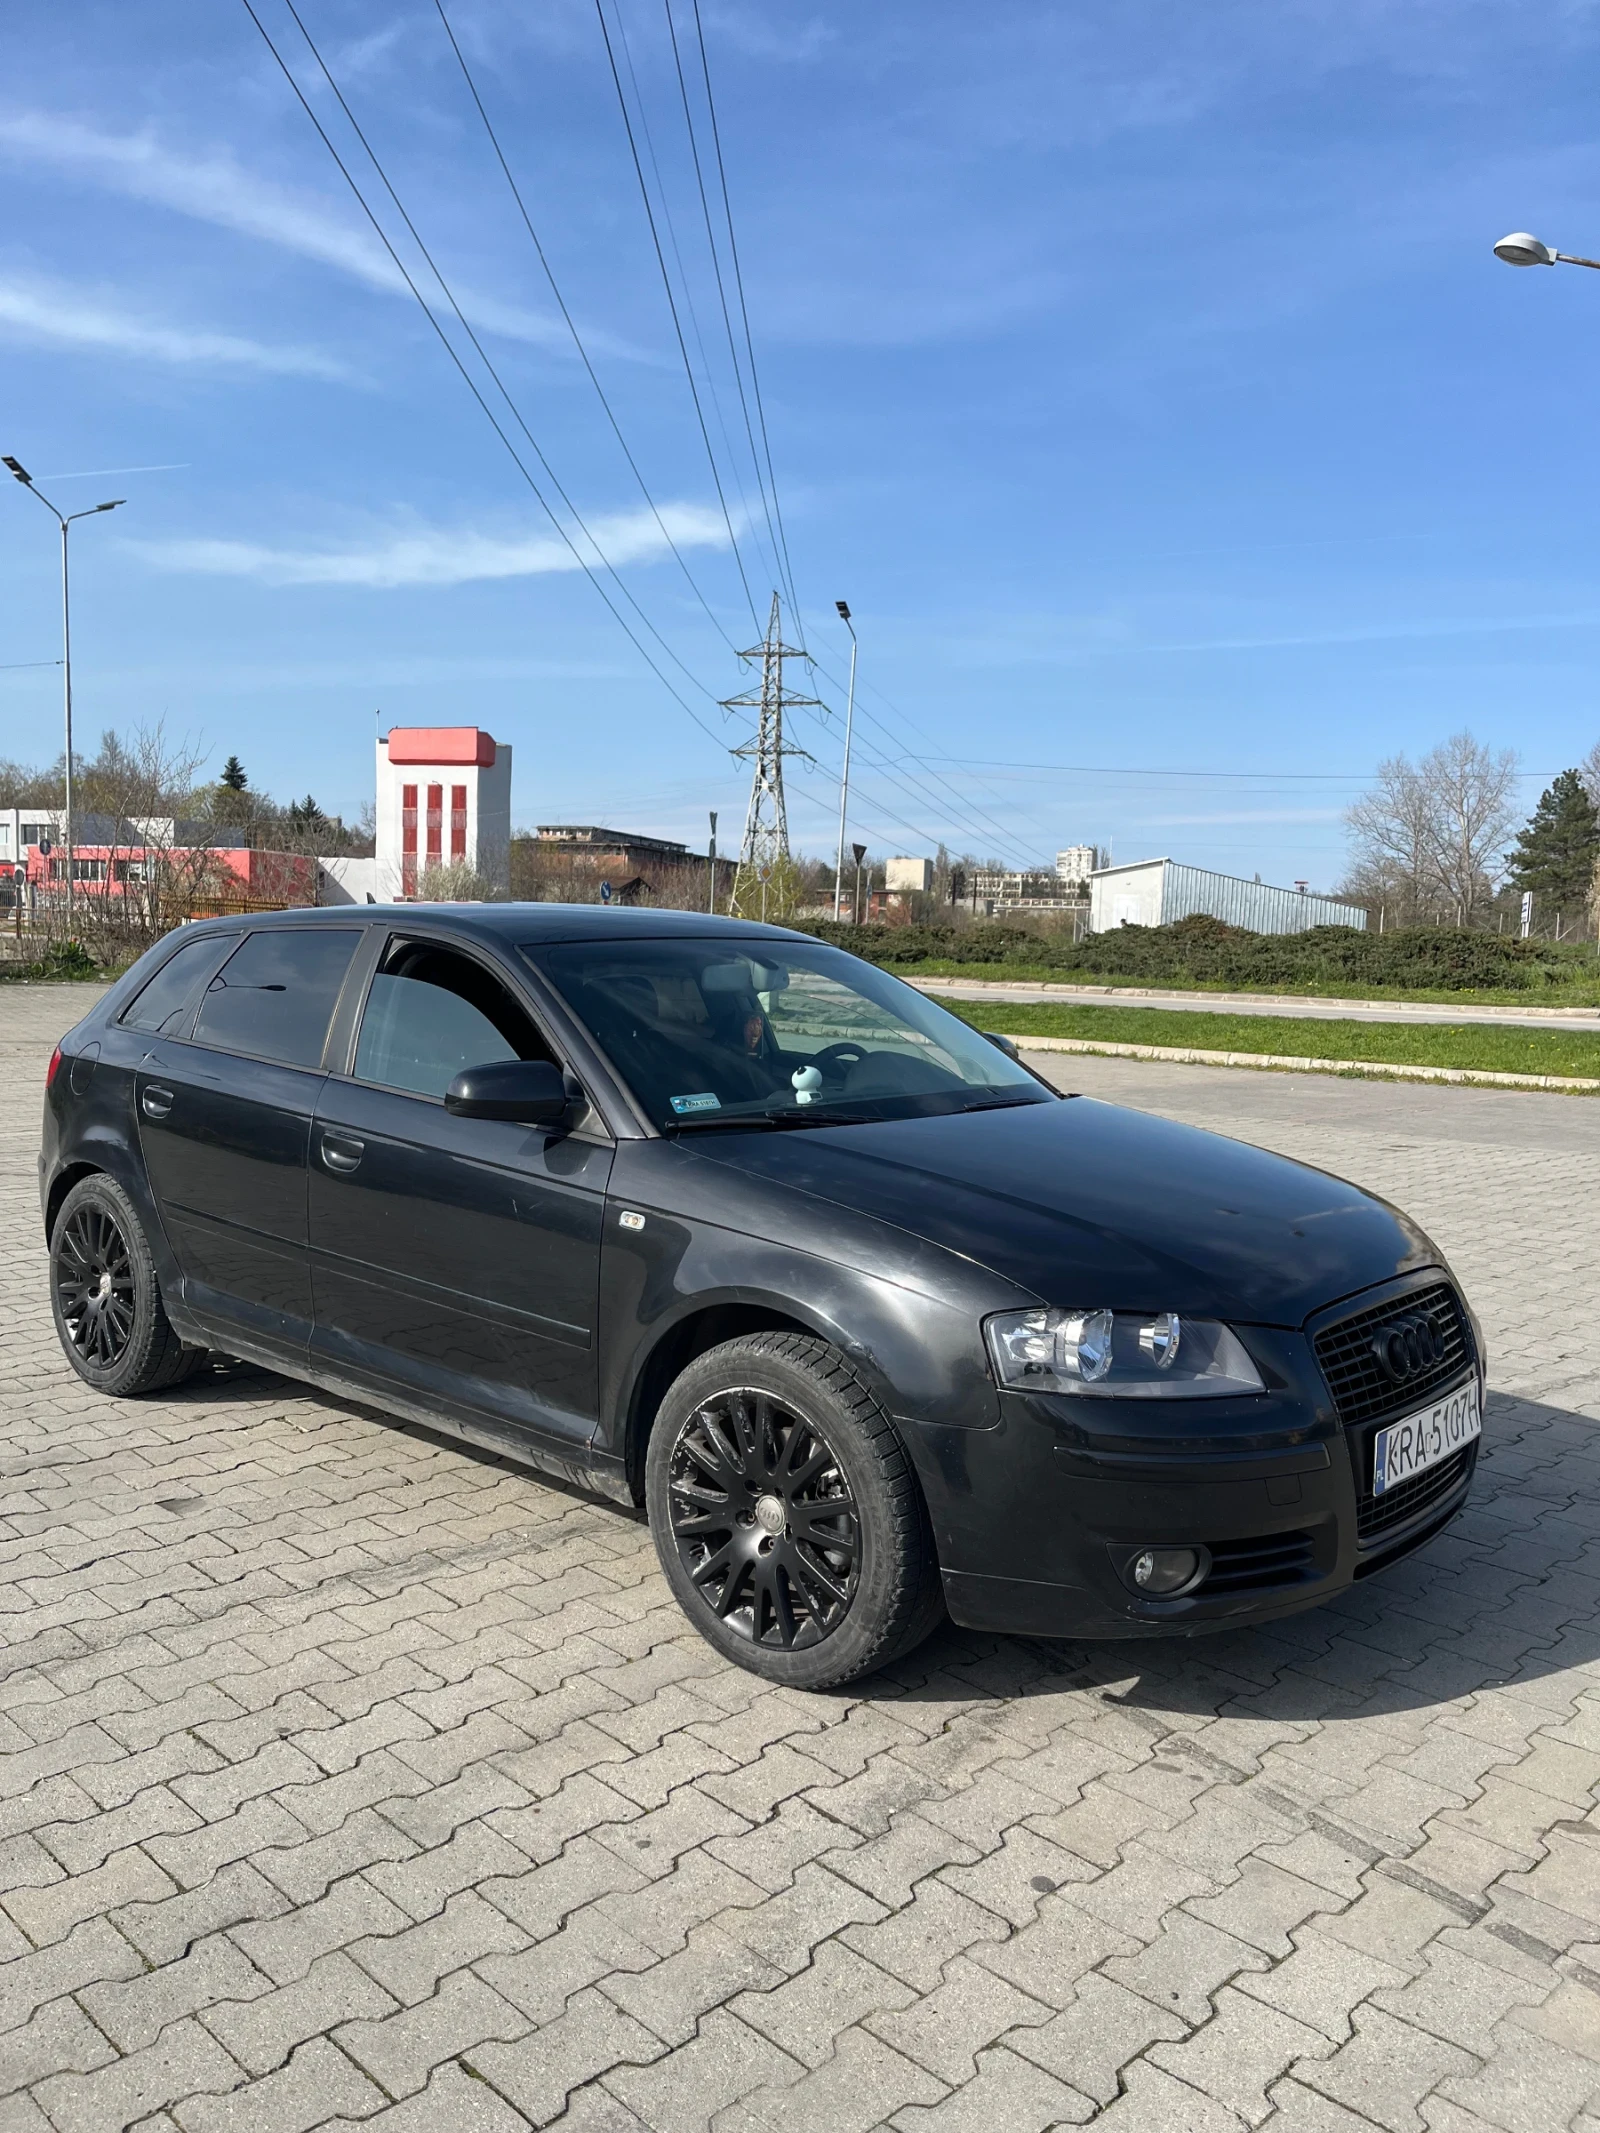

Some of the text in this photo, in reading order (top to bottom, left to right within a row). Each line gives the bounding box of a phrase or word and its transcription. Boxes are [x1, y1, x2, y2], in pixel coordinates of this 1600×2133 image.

[1387, 1385, 1479, 1481] KRA 5107H
[1376, 1469, 1384, 1484] PL
